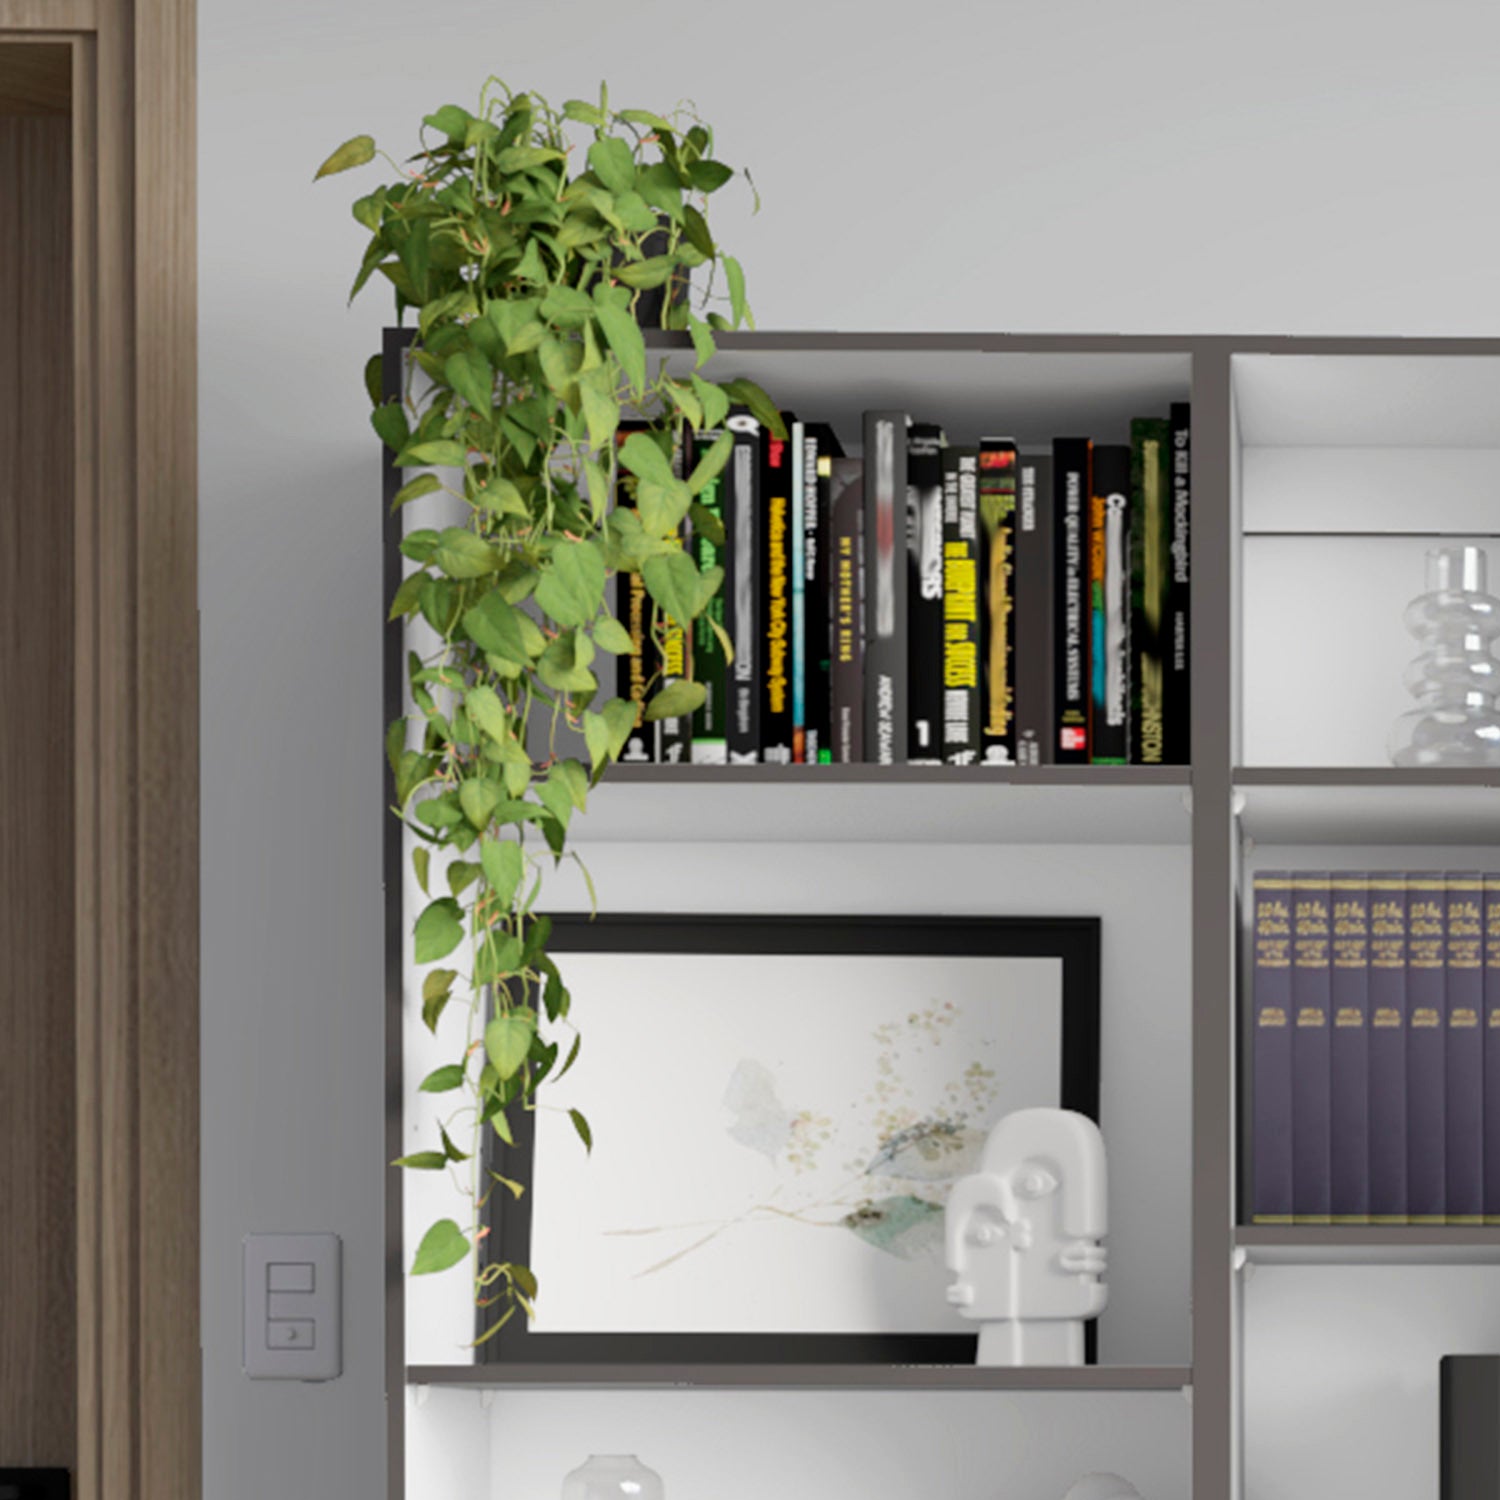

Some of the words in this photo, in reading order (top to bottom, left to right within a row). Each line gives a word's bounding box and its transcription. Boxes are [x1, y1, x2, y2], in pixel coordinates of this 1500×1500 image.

[1171, 490, 1188, 583] Mockingbird
[840, 560, 853, 625] MOTHER'S
[840, 629, 853, 662] RING
[944, 642, 976, 687] SUCCESS
